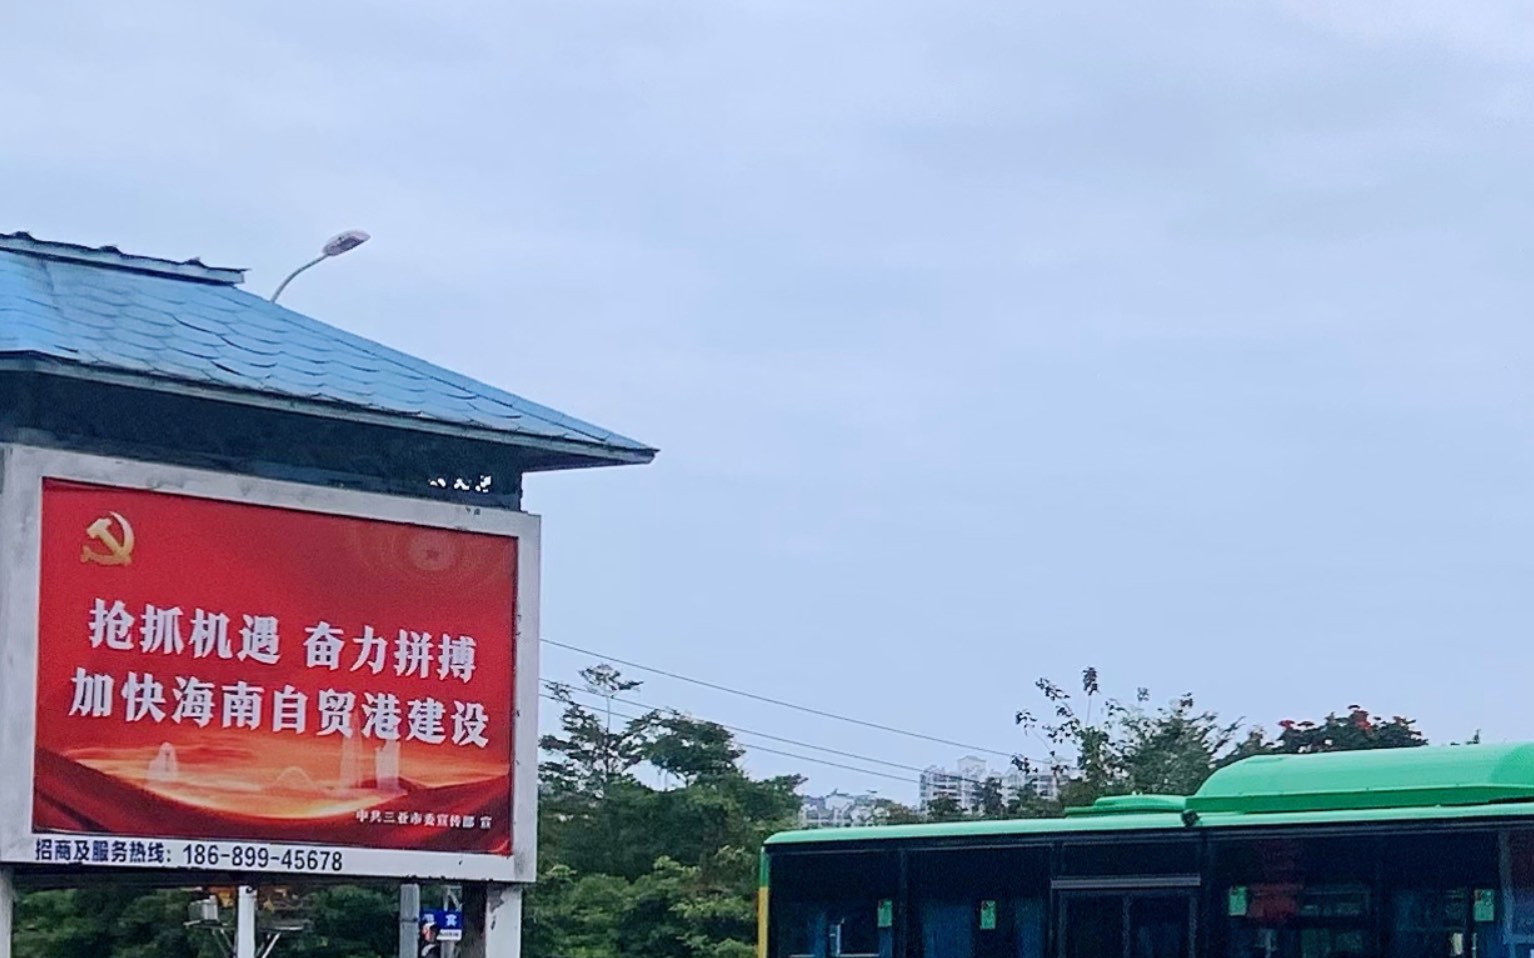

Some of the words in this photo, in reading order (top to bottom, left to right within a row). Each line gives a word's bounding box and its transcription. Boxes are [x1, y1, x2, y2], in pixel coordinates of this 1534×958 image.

[88, 597, 282, 666] 抢抓机遇
[304, 620, 478, 683] 奋力拼搏
[69, 667, 490, 749] 加快海南自贸港建设
[355, 809, 476, 829] 中共三亚市委宣传部
[35, 838, 172, 864] 招商及服务热线：
[182, 843, 343, 872] 186-899-45678
